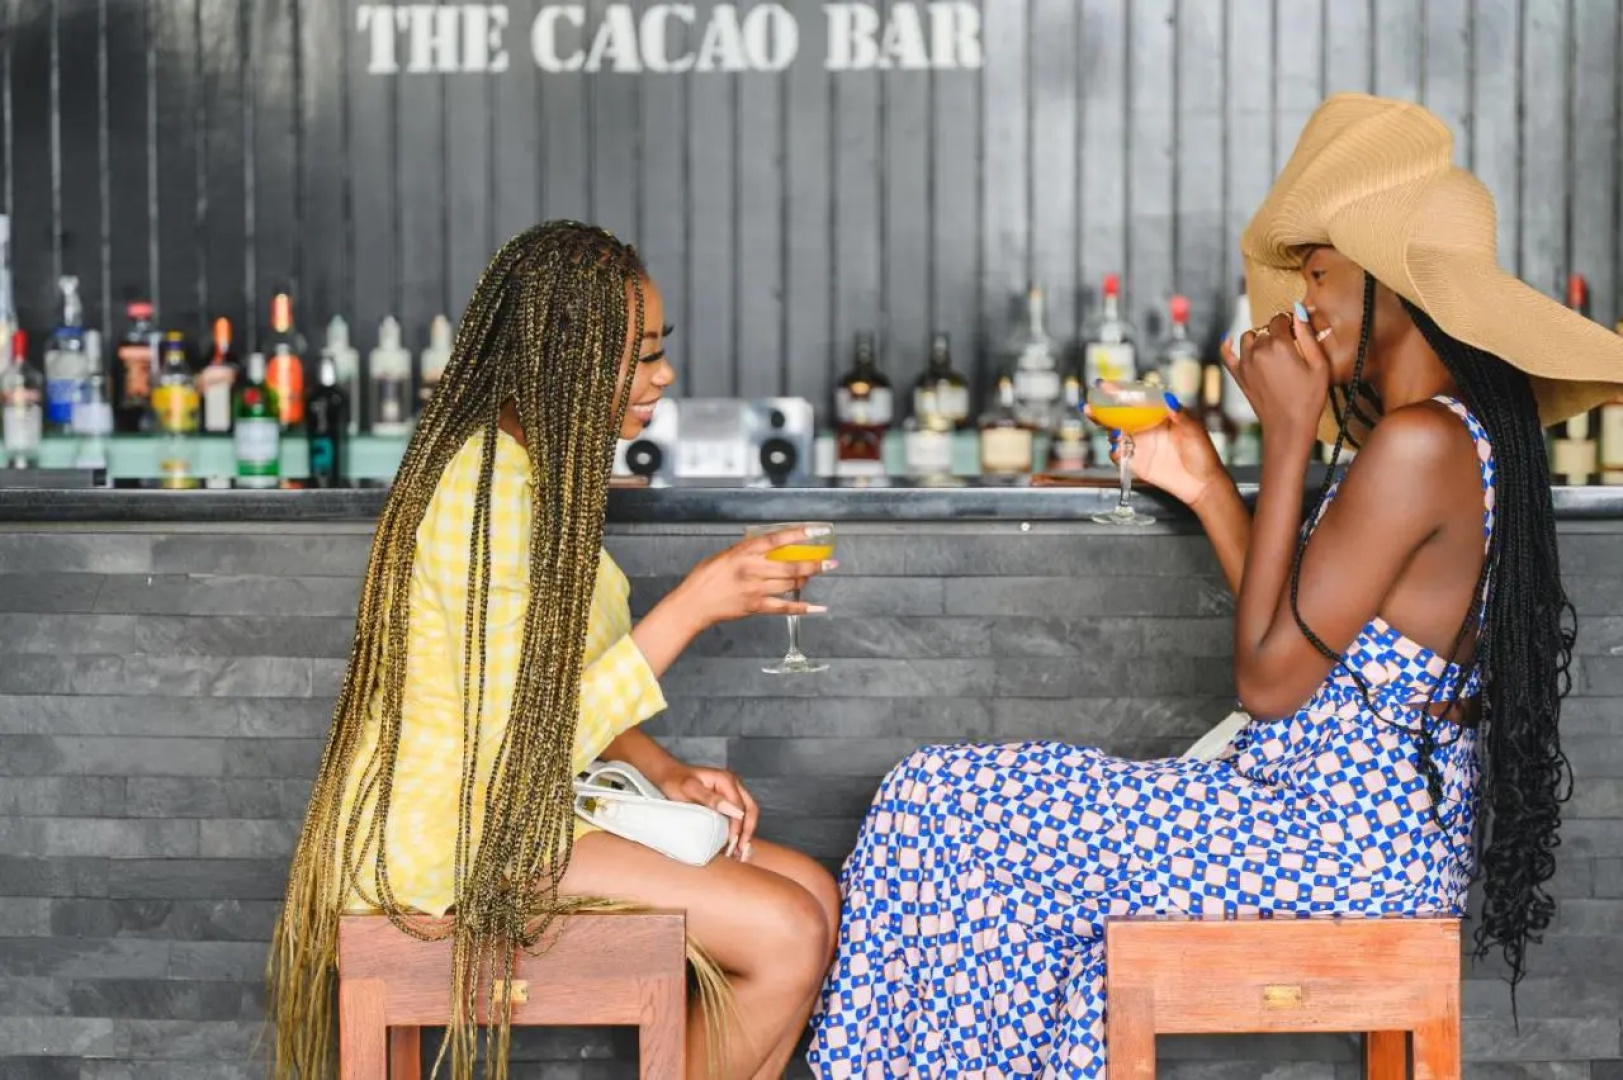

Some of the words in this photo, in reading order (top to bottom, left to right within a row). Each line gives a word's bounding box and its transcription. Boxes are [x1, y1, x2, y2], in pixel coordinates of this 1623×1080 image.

[356, 3, 509, 74] THE
[531, 3, 799, 74] CACAO
[824, 1, 982, 70] BAR
